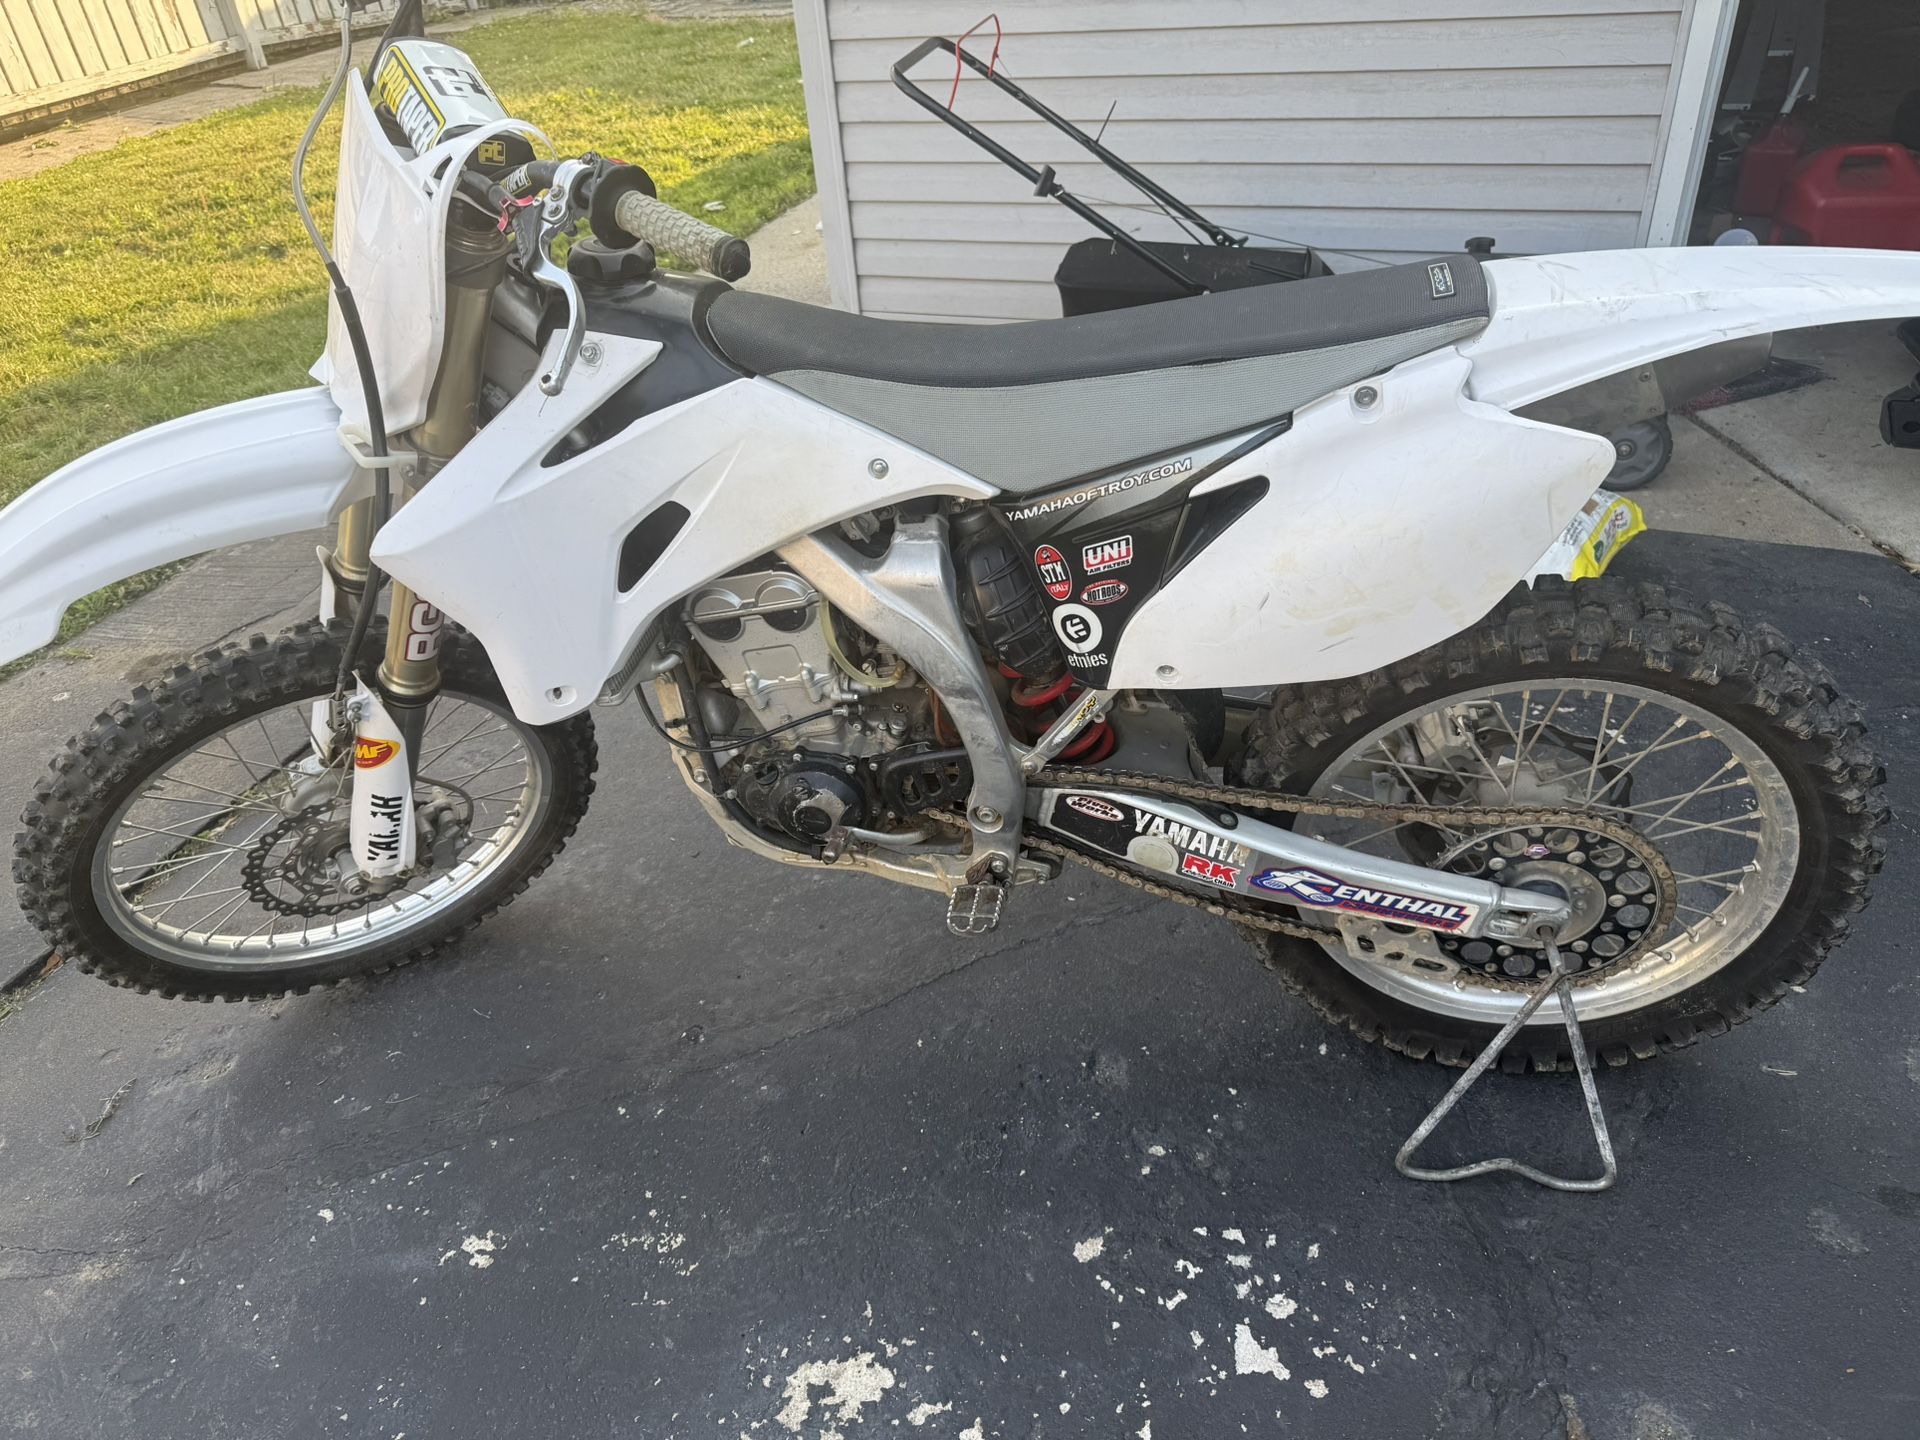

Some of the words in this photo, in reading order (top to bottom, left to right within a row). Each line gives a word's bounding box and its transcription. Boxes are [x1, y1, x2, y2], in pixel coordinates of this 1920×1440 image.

[1005, 457, 1192, 522] YAMAHAOFTROY.COM
[1086, 539, 1128, 566] UNI
[1040, 561, 1067, 584] STM
[1089, 566, 1101, 574] AIR
[1102, 560, 1130, 570] FILTERS
[1050, 583, 1070, 594] ITALY
[1087, 587, 1101, 602] HOT
[1101, 583, 1121, 598] RODS
[1067, 652, 1108, 669] etnies
[355, 742, 389, 759] MF
[1071, 801, 1120, 819] Works
[1077, 797, 1115, 812] Pivot
[1134, 809, 1251, 868] YAMAHA
[1182, 853, 1242, 886] RK
[1214, 878, 1235, 888] CHAIN
